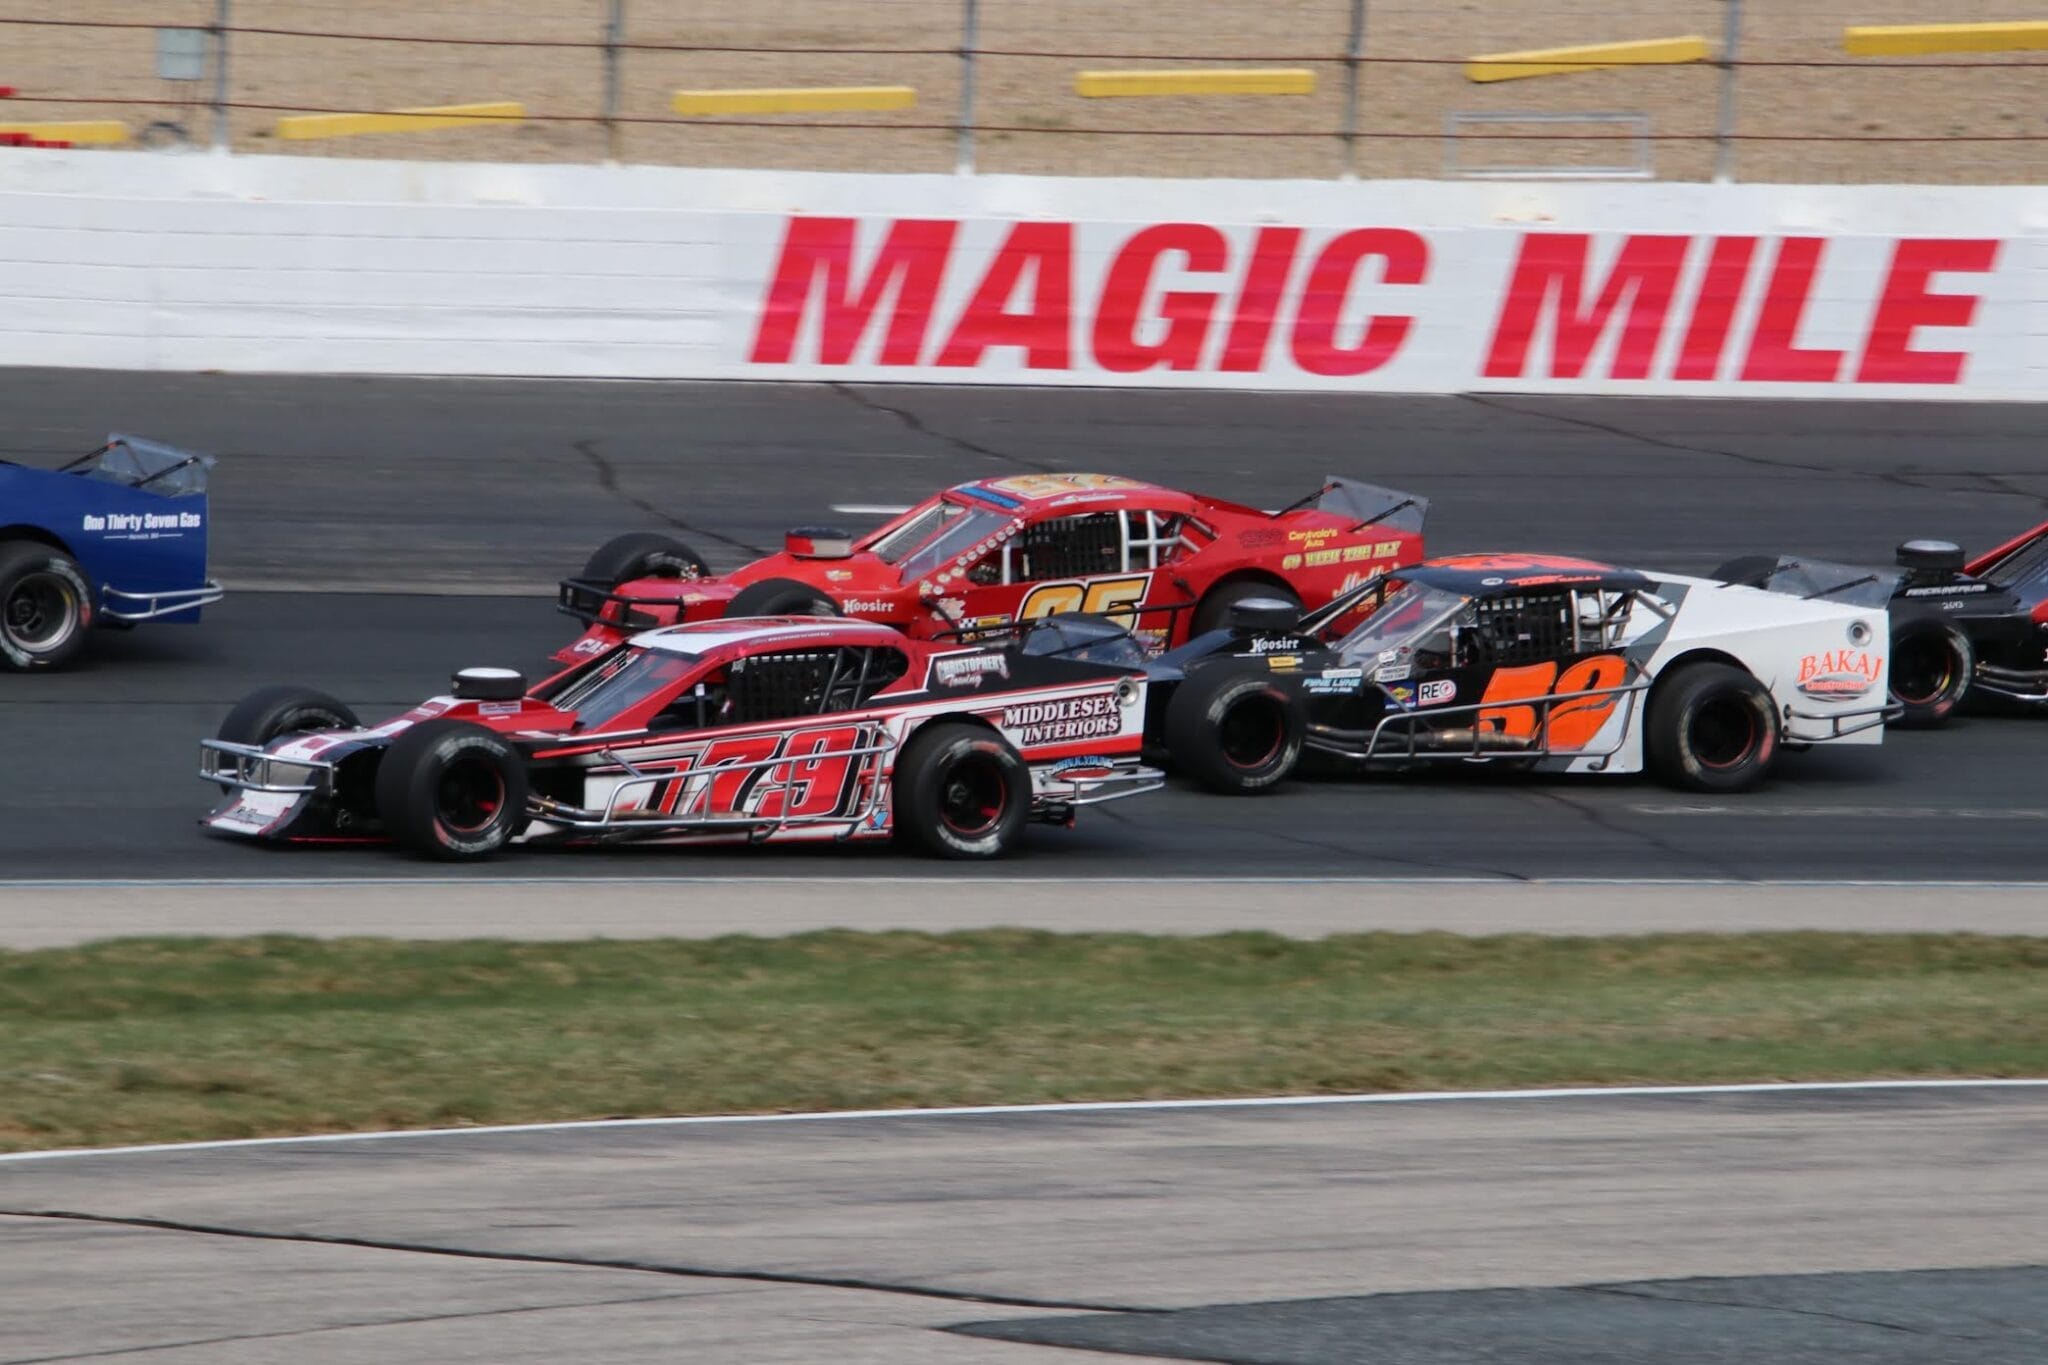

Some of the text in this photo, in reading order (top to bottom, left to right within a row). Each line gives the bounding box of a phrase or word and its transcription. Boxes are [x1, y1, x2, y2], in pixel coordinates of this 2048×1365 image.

[751, 215, 2003, 385] MAGIC MILE
[83, 512, 201, 532] One Thirty Seven Gas
[843, 599, 895, 614] Hoosier
[1249, 637, 1299, 653] Hoosier
[1797, 649, 1884, 684] BAKAJ
[1003, 696, 1119, 727] MIDDLESEX
[1468, 653, 1628, 751] 52
[1024, 716, 1119, 744] INTERIORS
